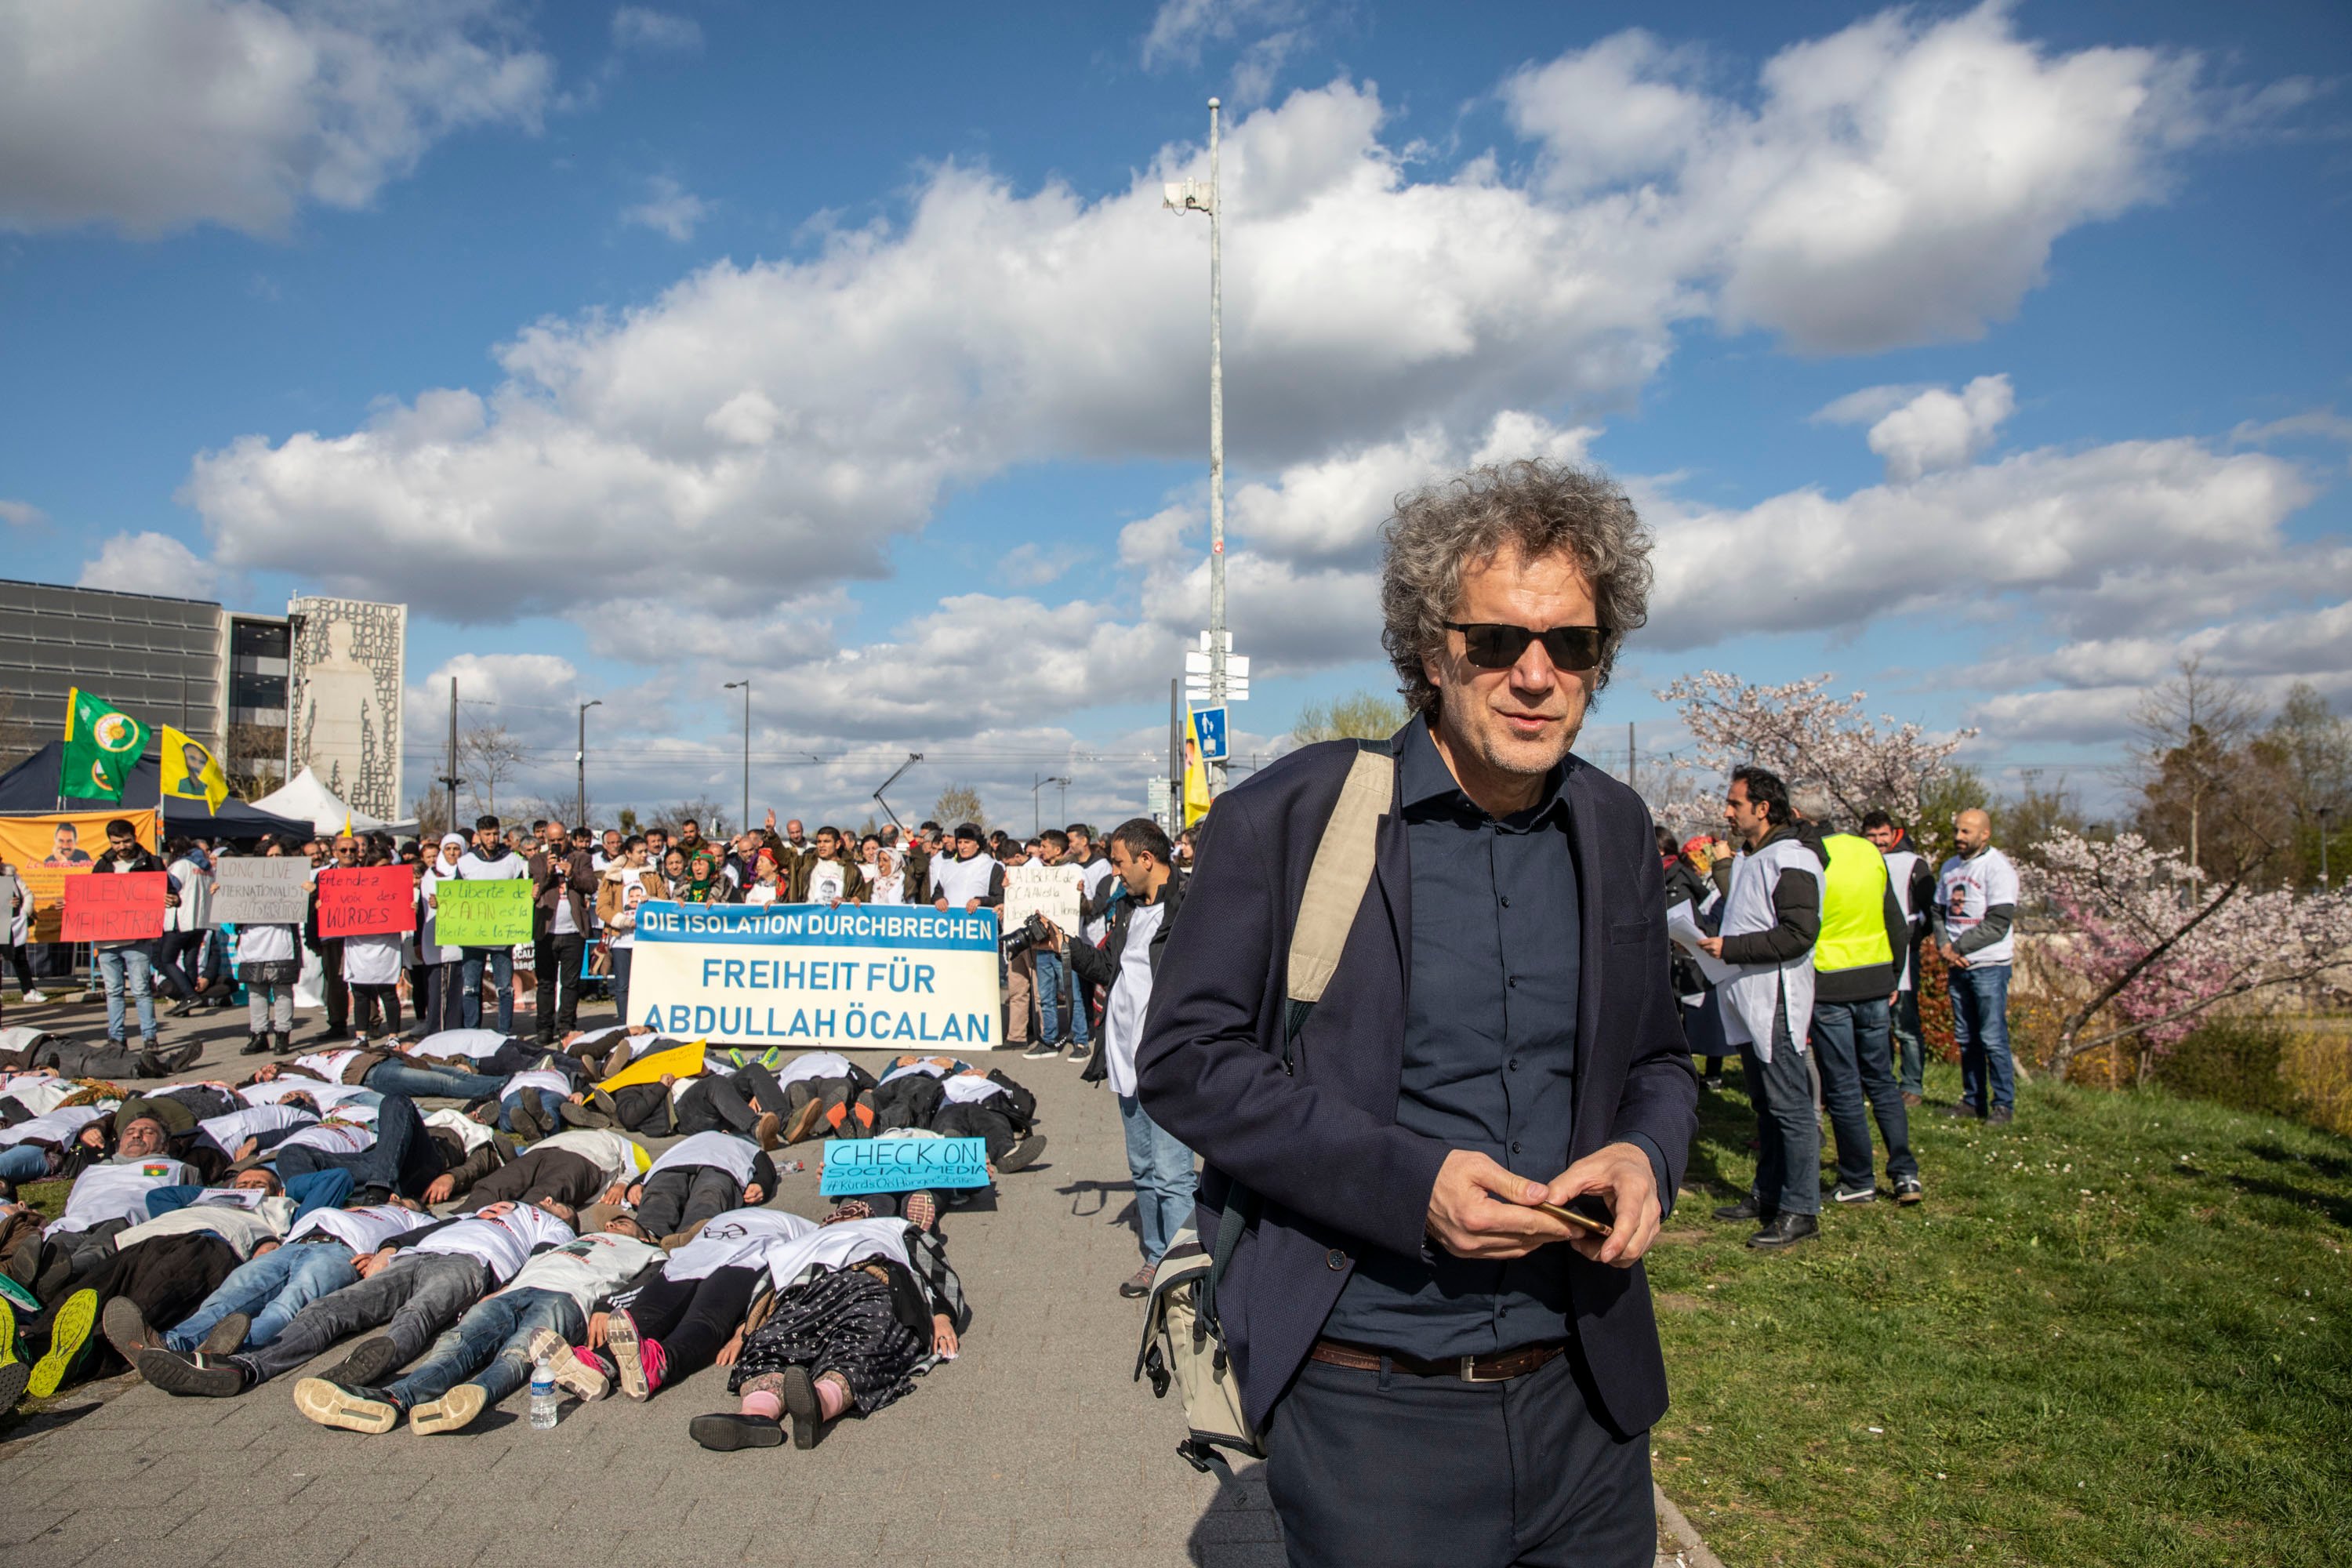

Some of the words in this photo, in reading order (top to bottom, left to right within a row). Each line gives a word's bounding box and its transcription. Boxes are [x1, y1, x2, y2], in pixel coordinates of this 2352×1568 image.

[223, 862, 253, 878] LONG
[263, 861, 293, 880] LIVE
[319, 872, 379, 886] Entendez
[67, 878, 162, 902] SILENCE
[340, 892, 363, 903] voix
[377, 890, 398, 901] des
[513, 884, 527, 898] de
[64, 909, 164, 938] MEURTRIER
[326, 906, 390, 928] KURDES
[643, 911, 680, 932] DIE
[684, 914, 804, 935] ISOLATION
[808, 914, 992, 941] DURCHBRECHEN
[702, 958, 860, 990] FREIHEIT
[867, 956, 935, 993] FÜR
[643, 1004, 836, 1039] ABDULLAH
[845, 1002, 990, 1043] ÖCALAN
[831, 1142, 935, 1167] CHECK
[944, 1142, 978, 1165] ON
[826, 1166, 921, 1178] SOCIAL
[925, 1164, 989, 1175] MEDIA
